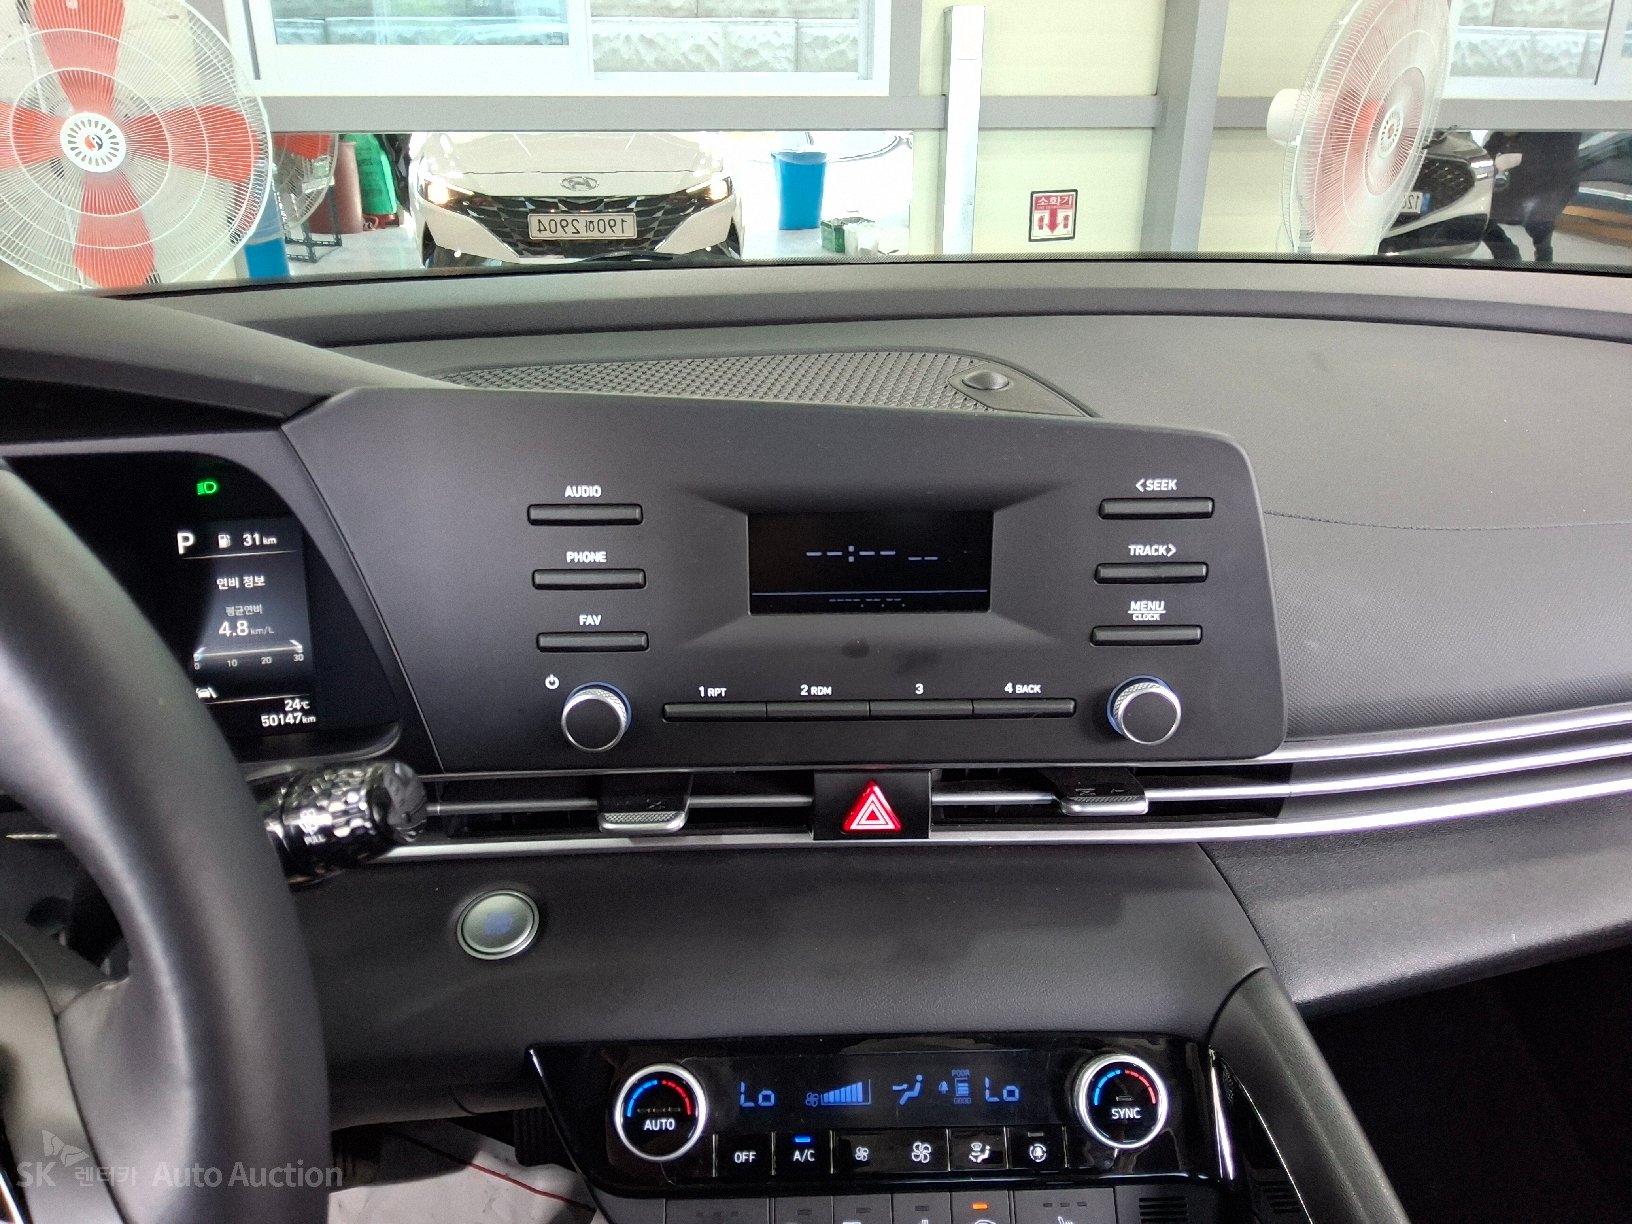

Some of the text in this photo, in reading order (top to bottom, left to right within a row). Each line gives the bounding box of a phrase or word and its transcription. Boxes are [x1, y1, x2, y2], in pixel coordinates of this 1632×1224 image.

[1036, 195, 1072, 206] 소화기
[564, 484, 602, 498] AUDIO
[177, 531, 194, 554] P
[243, 532, 277, 547] 31 km
[566, 551, 607, 563] PHONE
[216, 575, 266, 590] 연비 정보
[225, 604, 263, 617] 평균연비
[1130, 600, 1165, 612] MENU
[579, 615, 602, 626] FAV
[1132, 613, 1160, 621] CLOCK
[218, 619, 249, 638] 4.8
[227, 659, 239, 668] 10
[261, 656, 273, 665] 20
[293, 653, 305, 663] 30
[698, 686, 727, 697] 1 RPT
[801, 684, 832, 697] 2 RDM
[915, 683, 924, 695] 3
[1005, 682, 1041, 695] 4 BACK
[1111, 1108, 1142, 1120] SYNC
[644, 1118, 675, 1131] AUTO
[734, 1152, 756, 1163] OFF
[793, 1150, 814, 1162] A/C
